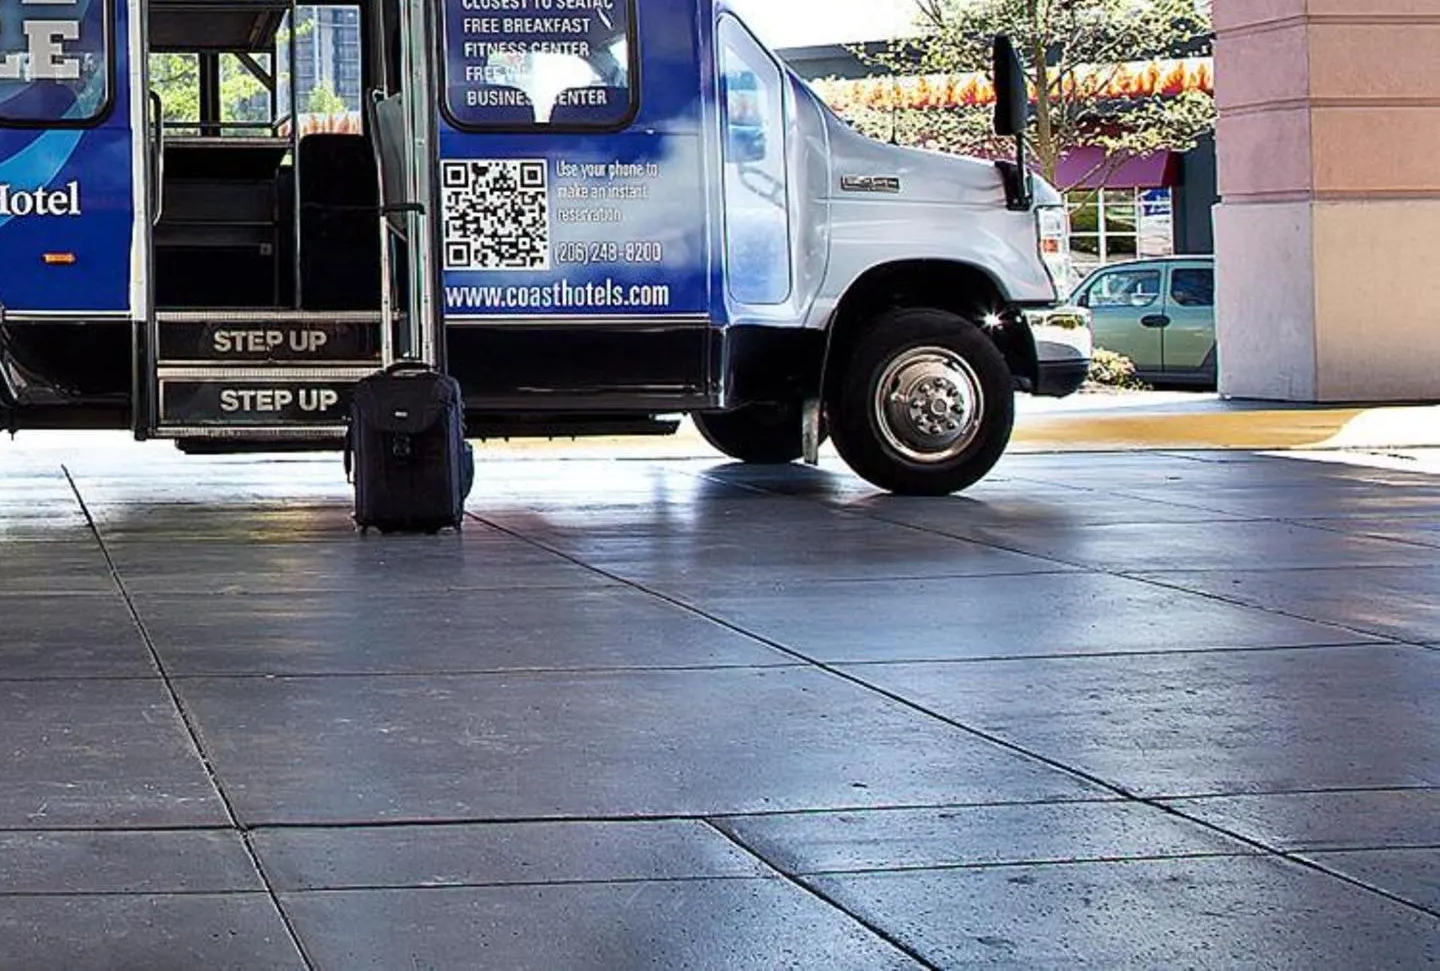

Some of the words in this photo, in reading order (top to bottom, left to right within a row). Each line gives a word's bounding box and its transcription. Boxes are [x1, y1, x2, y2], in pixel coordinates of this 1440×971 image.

[463, 18, 500, 33] FREE
[503, 17, 591, 34] BREAKFAST
[466, 66, 502, 82] FREE
[554, 89, 607, 106] ENTER
[556, 160, 578, 177] Use
[579, 163, 606, 180] your
[608, 160, 644, 181] phone
[646, 163, 659, 178] to
[554, 243, 588, 265] (206)
[445, 280, 669, 308] www.coasthotels.com
[213, 331, 282, 352] STEP
[288, 331, 328, 351] UP
[220, 389, 293, 412] STEP
[298, 389, 338, 412] UP
